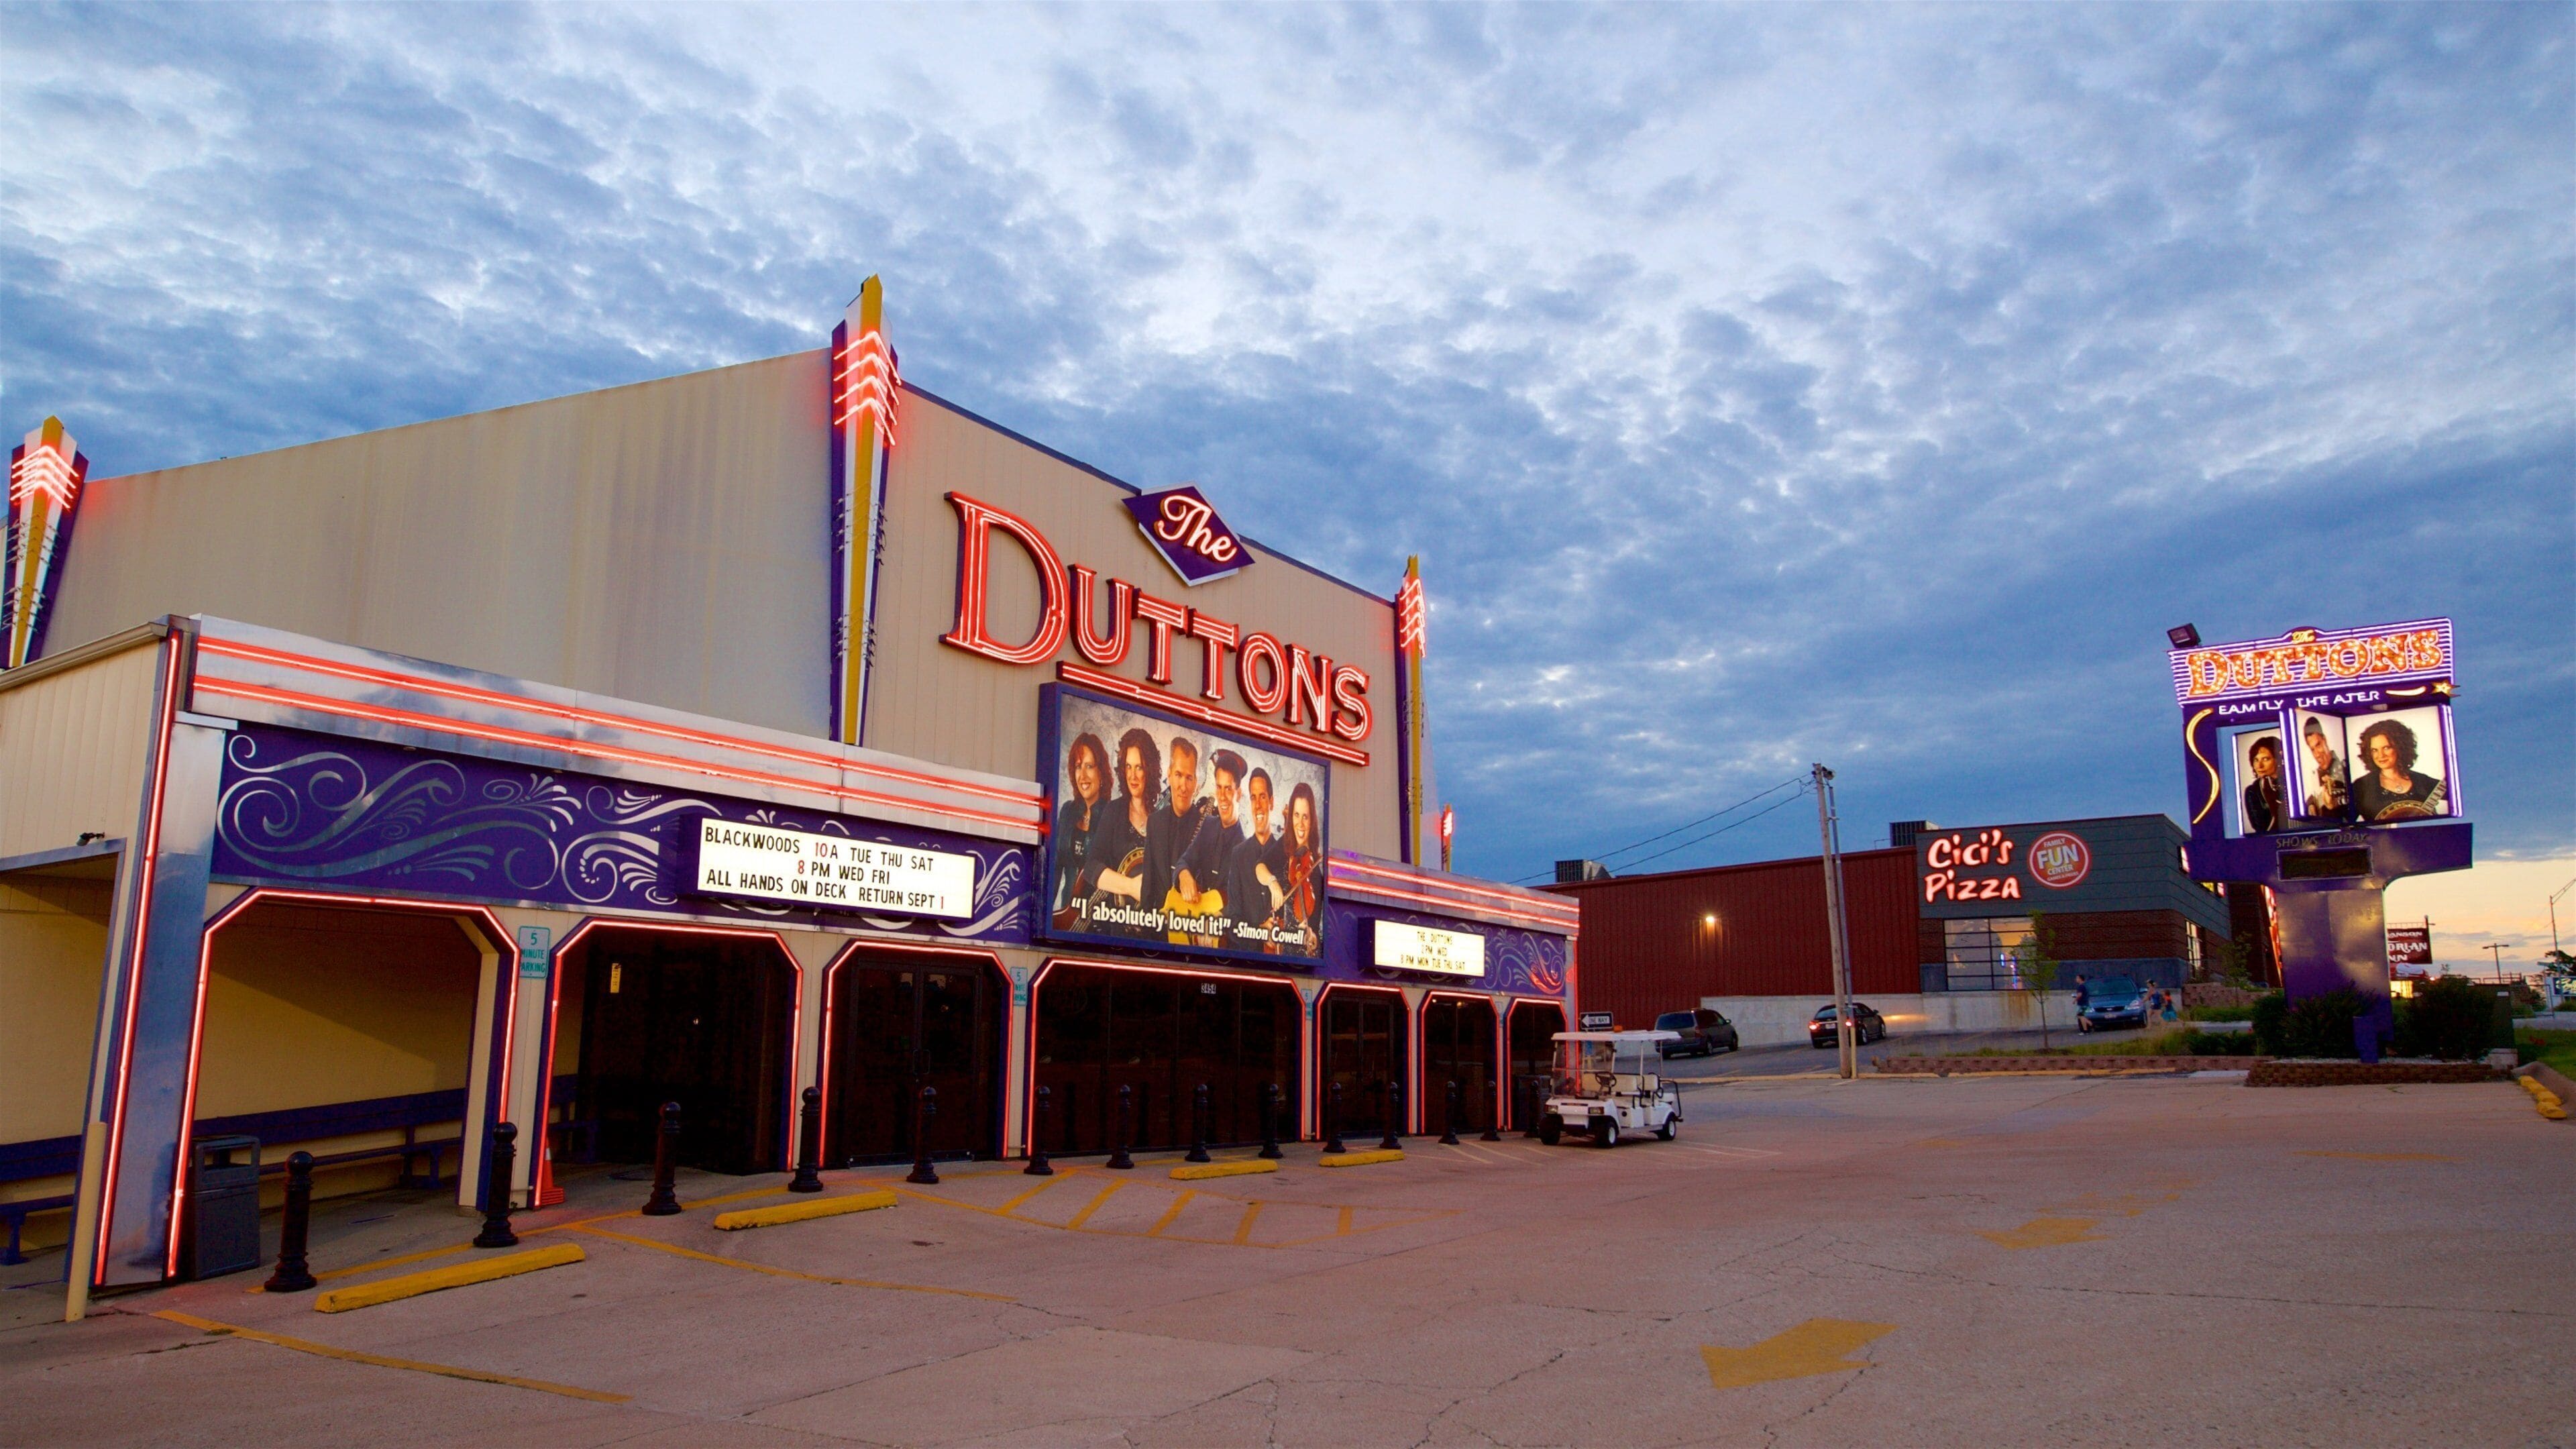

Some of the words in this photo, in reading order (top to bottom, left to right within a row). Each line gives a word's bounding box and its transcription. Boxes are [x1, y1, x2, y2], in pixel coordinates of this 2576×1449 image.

[1153, 494, 1237, 564] The
[940, 491, 1372, 742] DUTTONS
[2185, 629, 2444, 699] DUTTONS
[705, 826, 800, 853] BLACKWOODS
[851, 847, 871, 863] TUE
[881, 851, 902, 867] THU
[911, 856, 933, 871] SAT
[1927, 828, 2013, 869] Cici's
[2043, 838, 2065, 848] FAMILY
[2276, 836, 2318, 848] SHOWS
[2328, 833, 2369, 845] TODAY
[2037, 843, 2079, 869] FUN
[798, 860, 804, 874] 8
[812, 863, 830, 877] PM
[839, 865, 864, 881] WED
[872, 870, 890, 884] FRI
[2047, 864, 2074, 875] CENTER
[706, 869, 731, 887] ALL
[740, 873, 782, 892] HANDS
[792, 879, 808, 895] ON
[816, 882, 846, 899] DECK
[859, 888, 903, 905] RETURN
[908, 892, 935, 908] SEPT
[941, 896, 944, 909] 1
[1924, 869, 2021, 903] Pizza
[1092, 902, 1165, 932] absolutely
[1169, 911, 1205, 934] loved
[1233, 924, 1268, 941] -Simon
[1272, 926, 1303, 945] Cowell
[531, 932, 537, 945] 5
[1417, 931, 1426, 941] THE
[521, 949, 545, 959] MINUTE
[1406, 955, 1414, 964] PM
[1417, 957, 1429, 966] MON
[1432, 959, 1441, 968] TUE
[1444, 959, 1452, 969] THU
[1456, 961, 1465, 971] SAT
[519, 961, 545, 973] ARKING
[1016, 971, 1021, 981] 5
